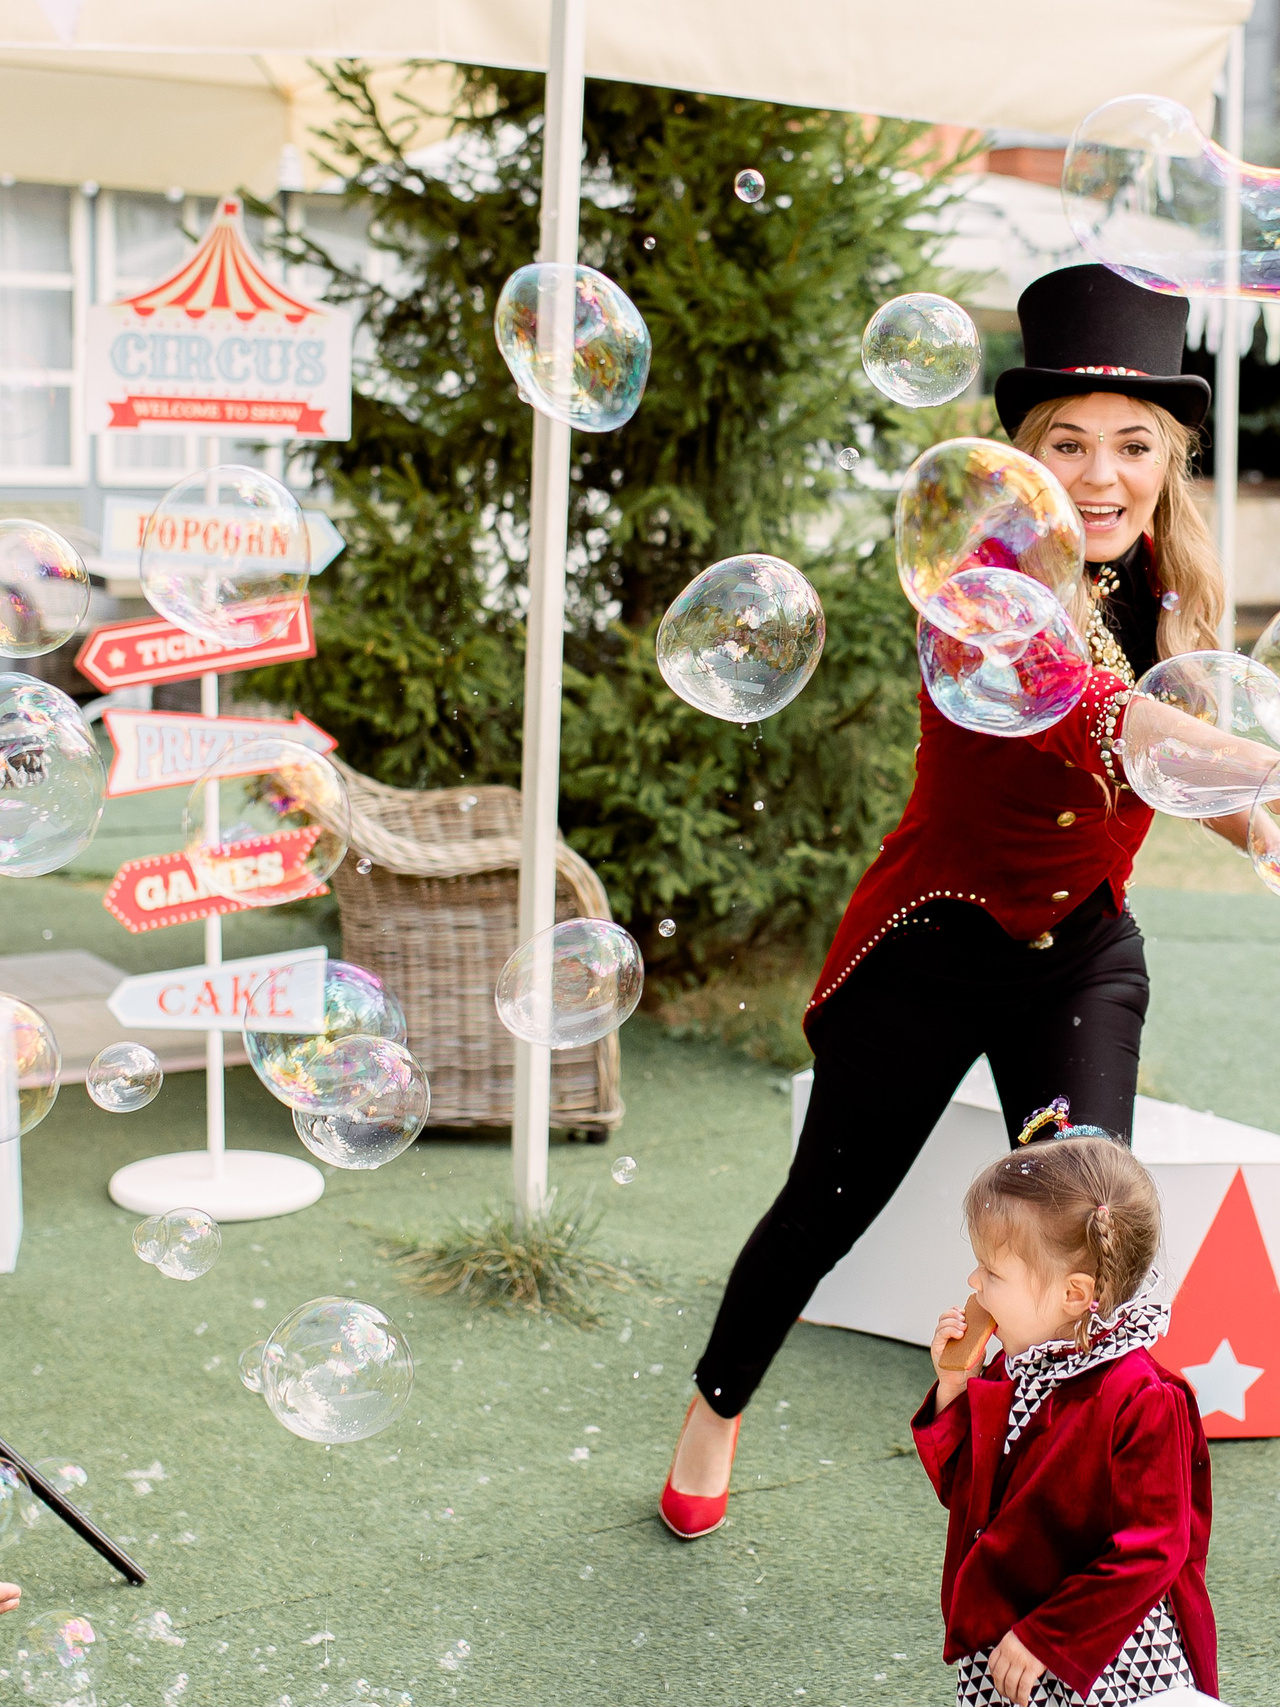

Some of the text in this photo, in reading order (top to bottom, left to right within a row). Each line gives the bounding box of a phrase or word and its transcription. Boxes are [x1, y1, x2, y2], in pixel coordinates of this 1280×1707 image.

[110, 332, 326, 387] CIRCUS
[132, 399, 303, 422] WELCOME TO SHOW
[137, 513, 289, 558] POPCORN
[135, 620, 253, 666] TICK
[135, 852, 286, 911] GAMES
[158, 966, 294, 1018] CAKE
